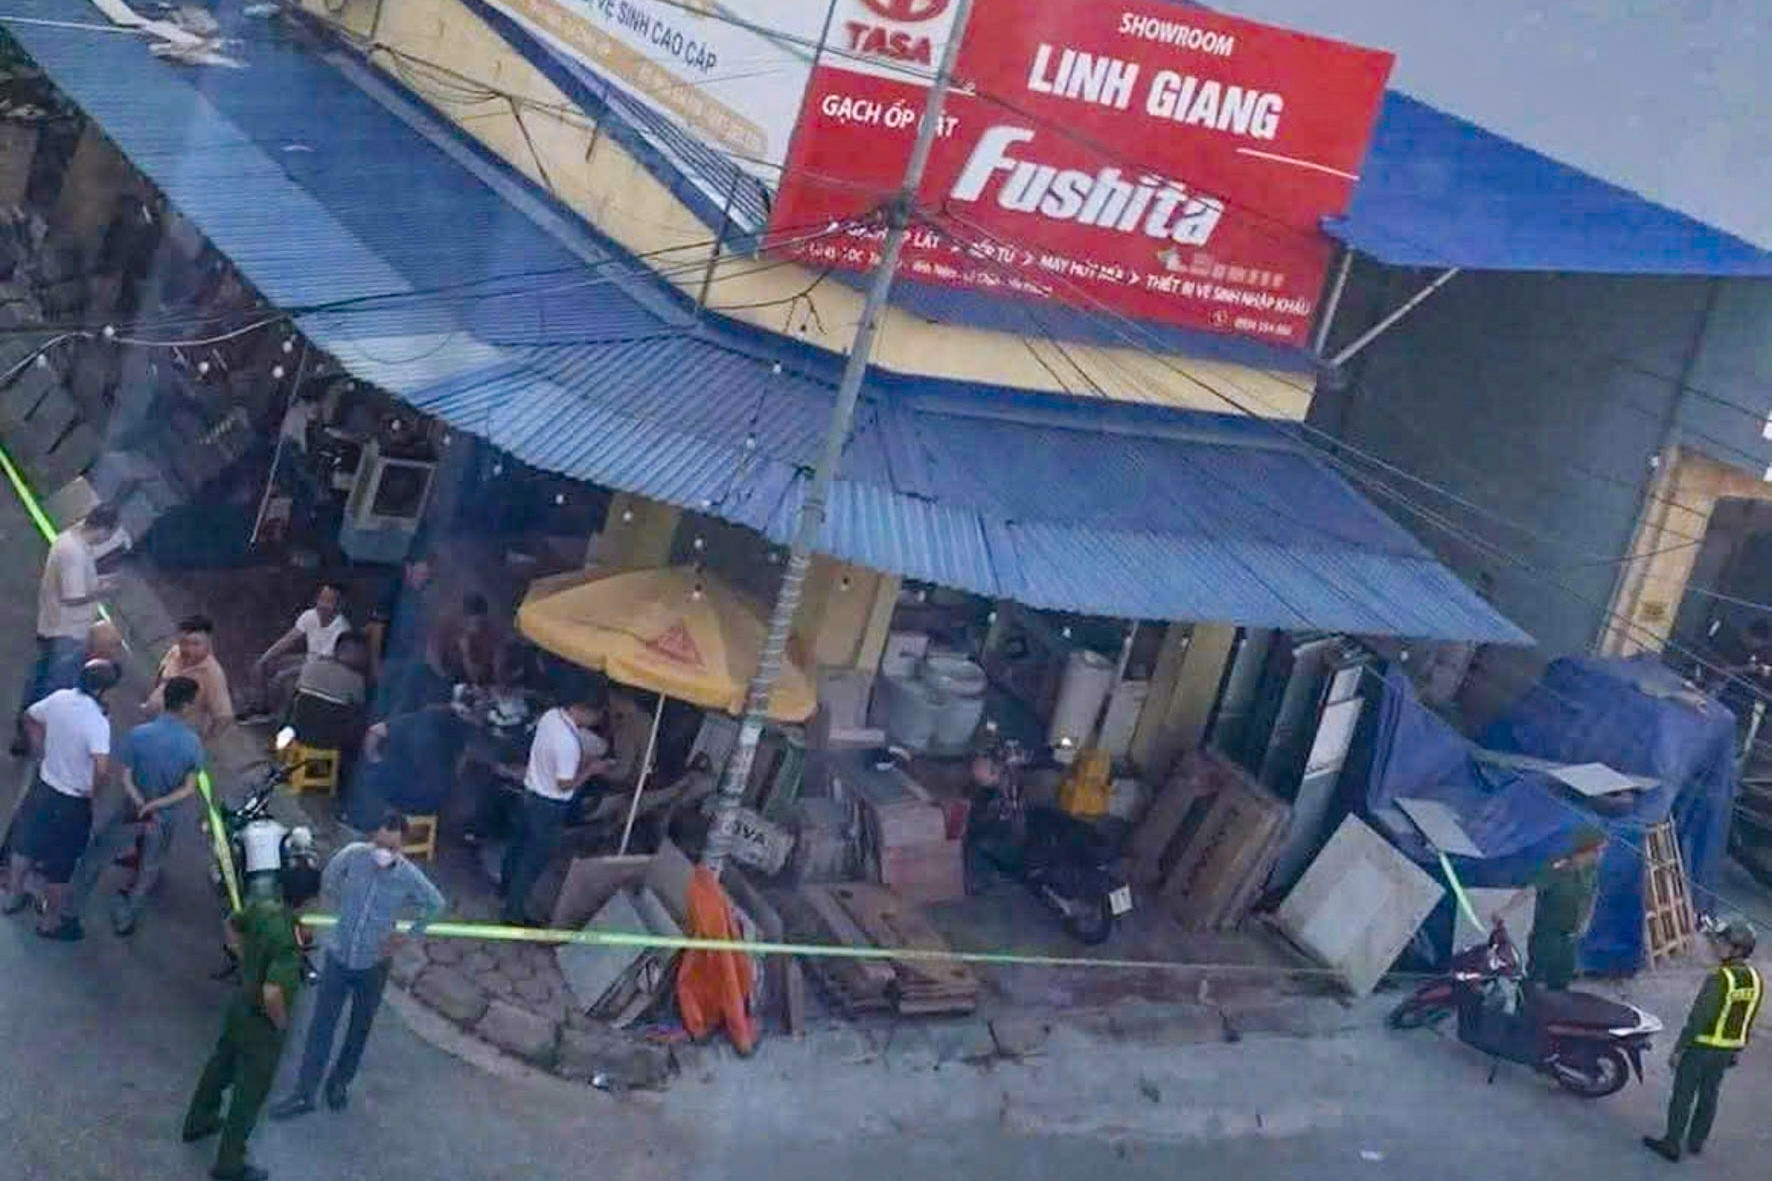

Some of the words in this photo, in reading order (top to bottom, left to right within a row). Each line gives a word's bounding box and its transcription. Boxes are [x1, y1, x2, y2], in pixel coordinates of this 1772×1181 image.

[617, 1, 650, 36] SINH
[651, 21, 684, 56] CAO
[847, 21, 933, 66] TASA
[1119, 12, 1234, 56] SHOWROOM
[822, 95, 881, 125] GẠCH
[884, 99, 915, 129] ỐP
[1028, 44, 1140, 110] LINH
[1146, 70, 1284, 140] GIANG
